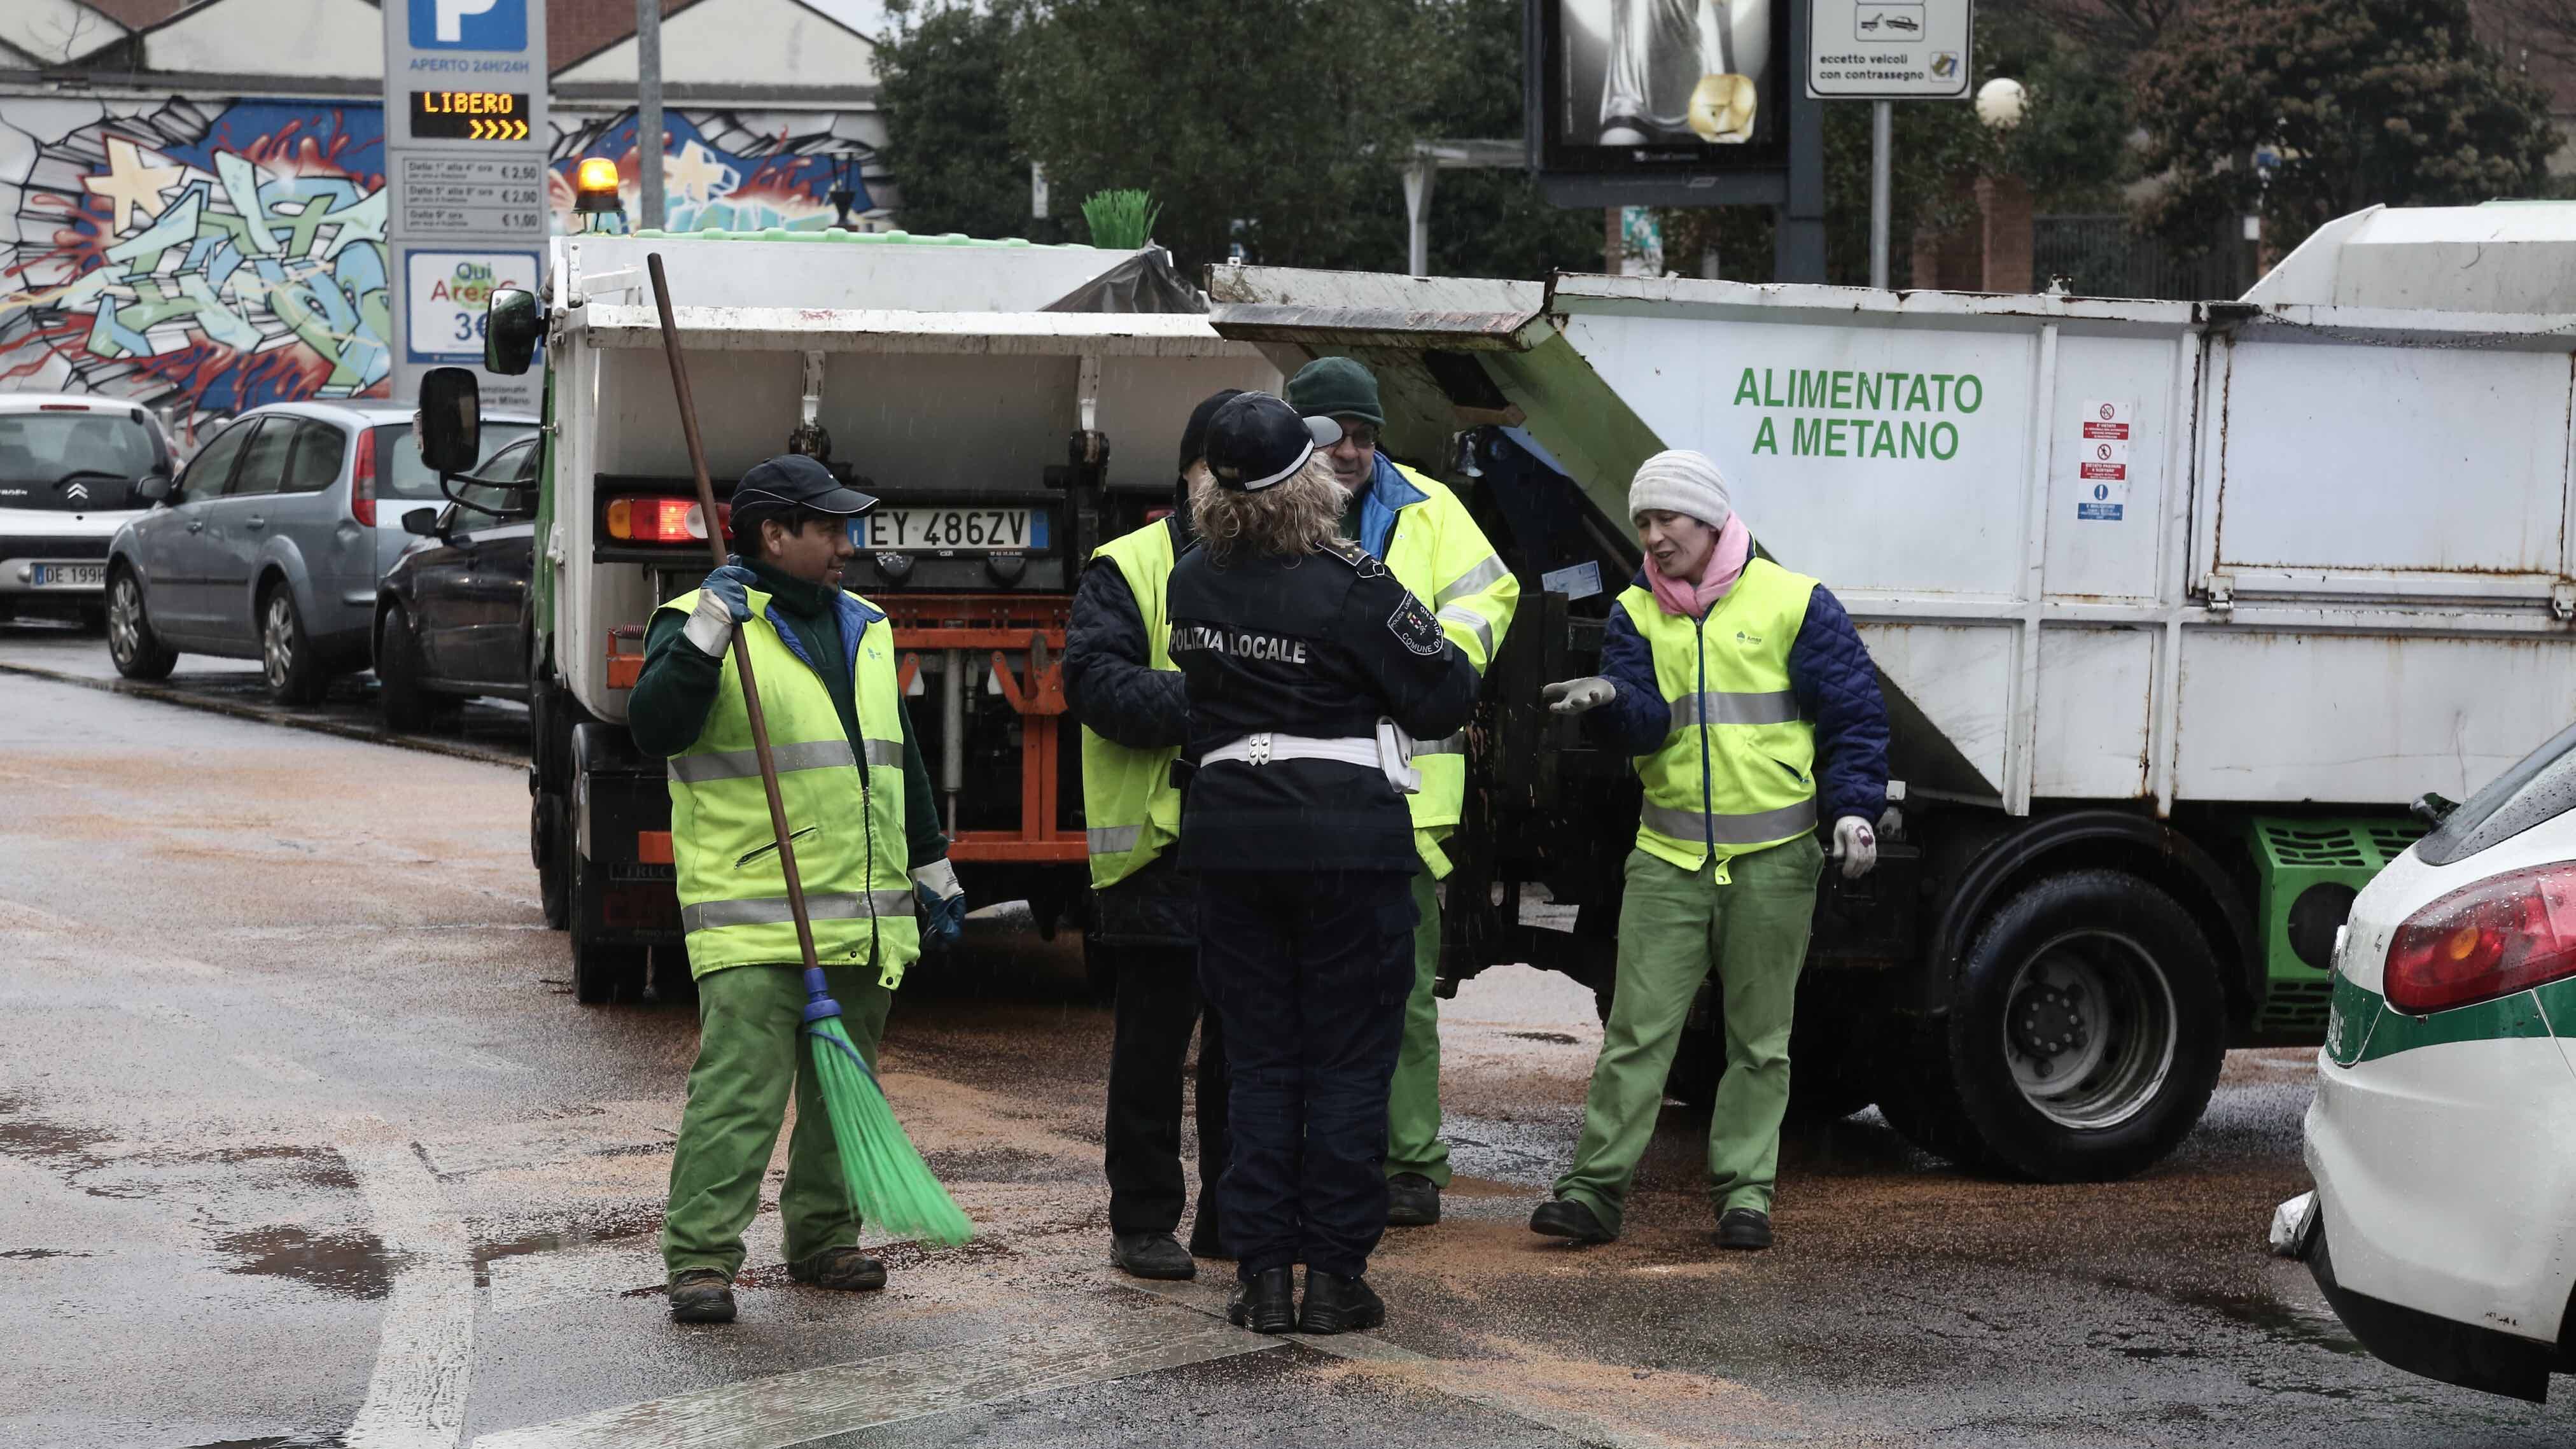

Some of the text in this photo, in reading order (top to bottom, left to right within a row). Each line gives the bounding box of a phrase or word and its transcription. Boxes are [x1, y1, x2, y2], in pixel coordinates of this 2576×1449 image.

[435, 0, 499, 41] P
[410, 59, 470, 71] APERTO
[1820, 54, 1908, 64] eccetto veicoli
[1819, 70, 1924, 81] con contrassegno
[424, 92, 513, 114] LIBERO
[456, 262, 492, 280] Qui
[1733, 368, 1983, 414] ALIMENTATO
[1751, 417, 1959, 461] A METANO
[871, 512, 1026, 546] EY 486ZV
[46, 567, 106, 582] DE 199H
[1402, 606, 1441, 653] COMUNE DI MILANO
[1170, 627, 1306, 664] POLIZIA LOCALE
